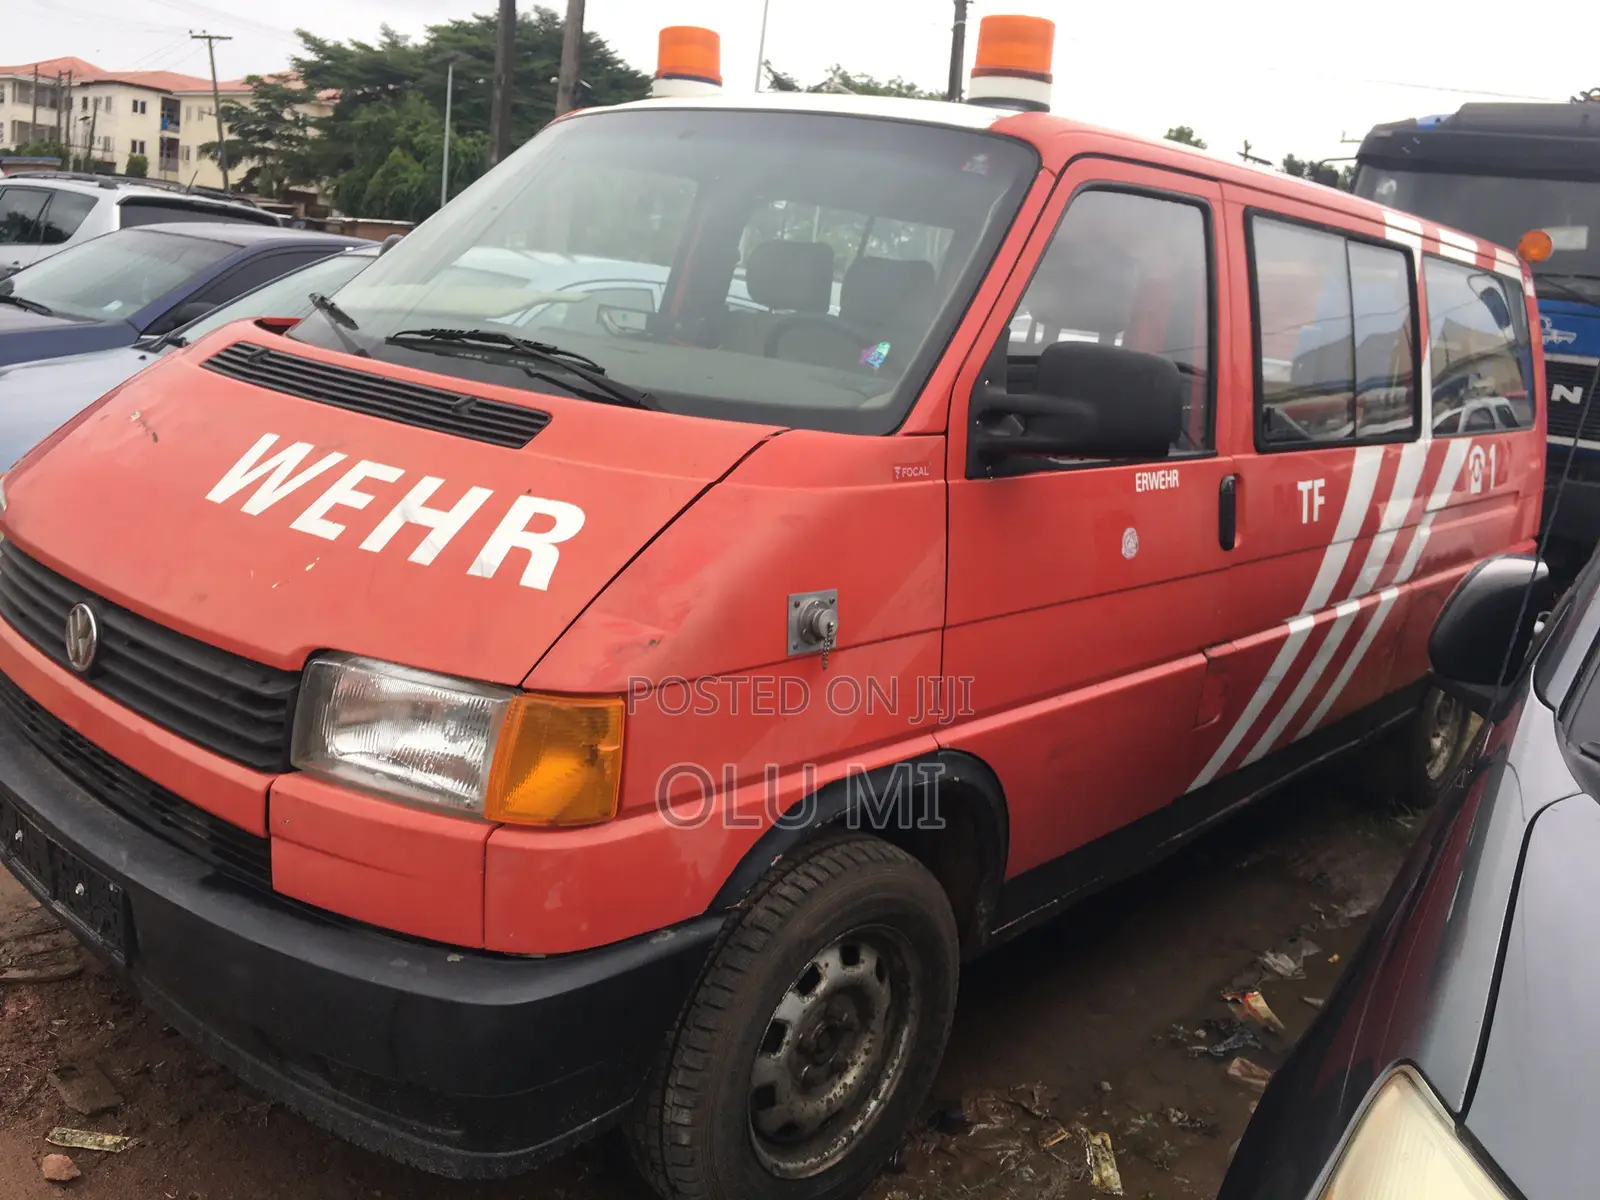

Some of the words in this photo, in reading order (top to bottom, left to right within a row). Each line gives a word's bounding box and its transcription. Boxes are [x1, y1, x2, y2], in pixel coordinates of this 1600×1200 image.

[901, 466, 930, 478] FOCAL
[1135, 469, 1180, 493] ERWEHR
[205, 432, 587, 591] WEHR
[1297, 478, 1326, 524] TF
